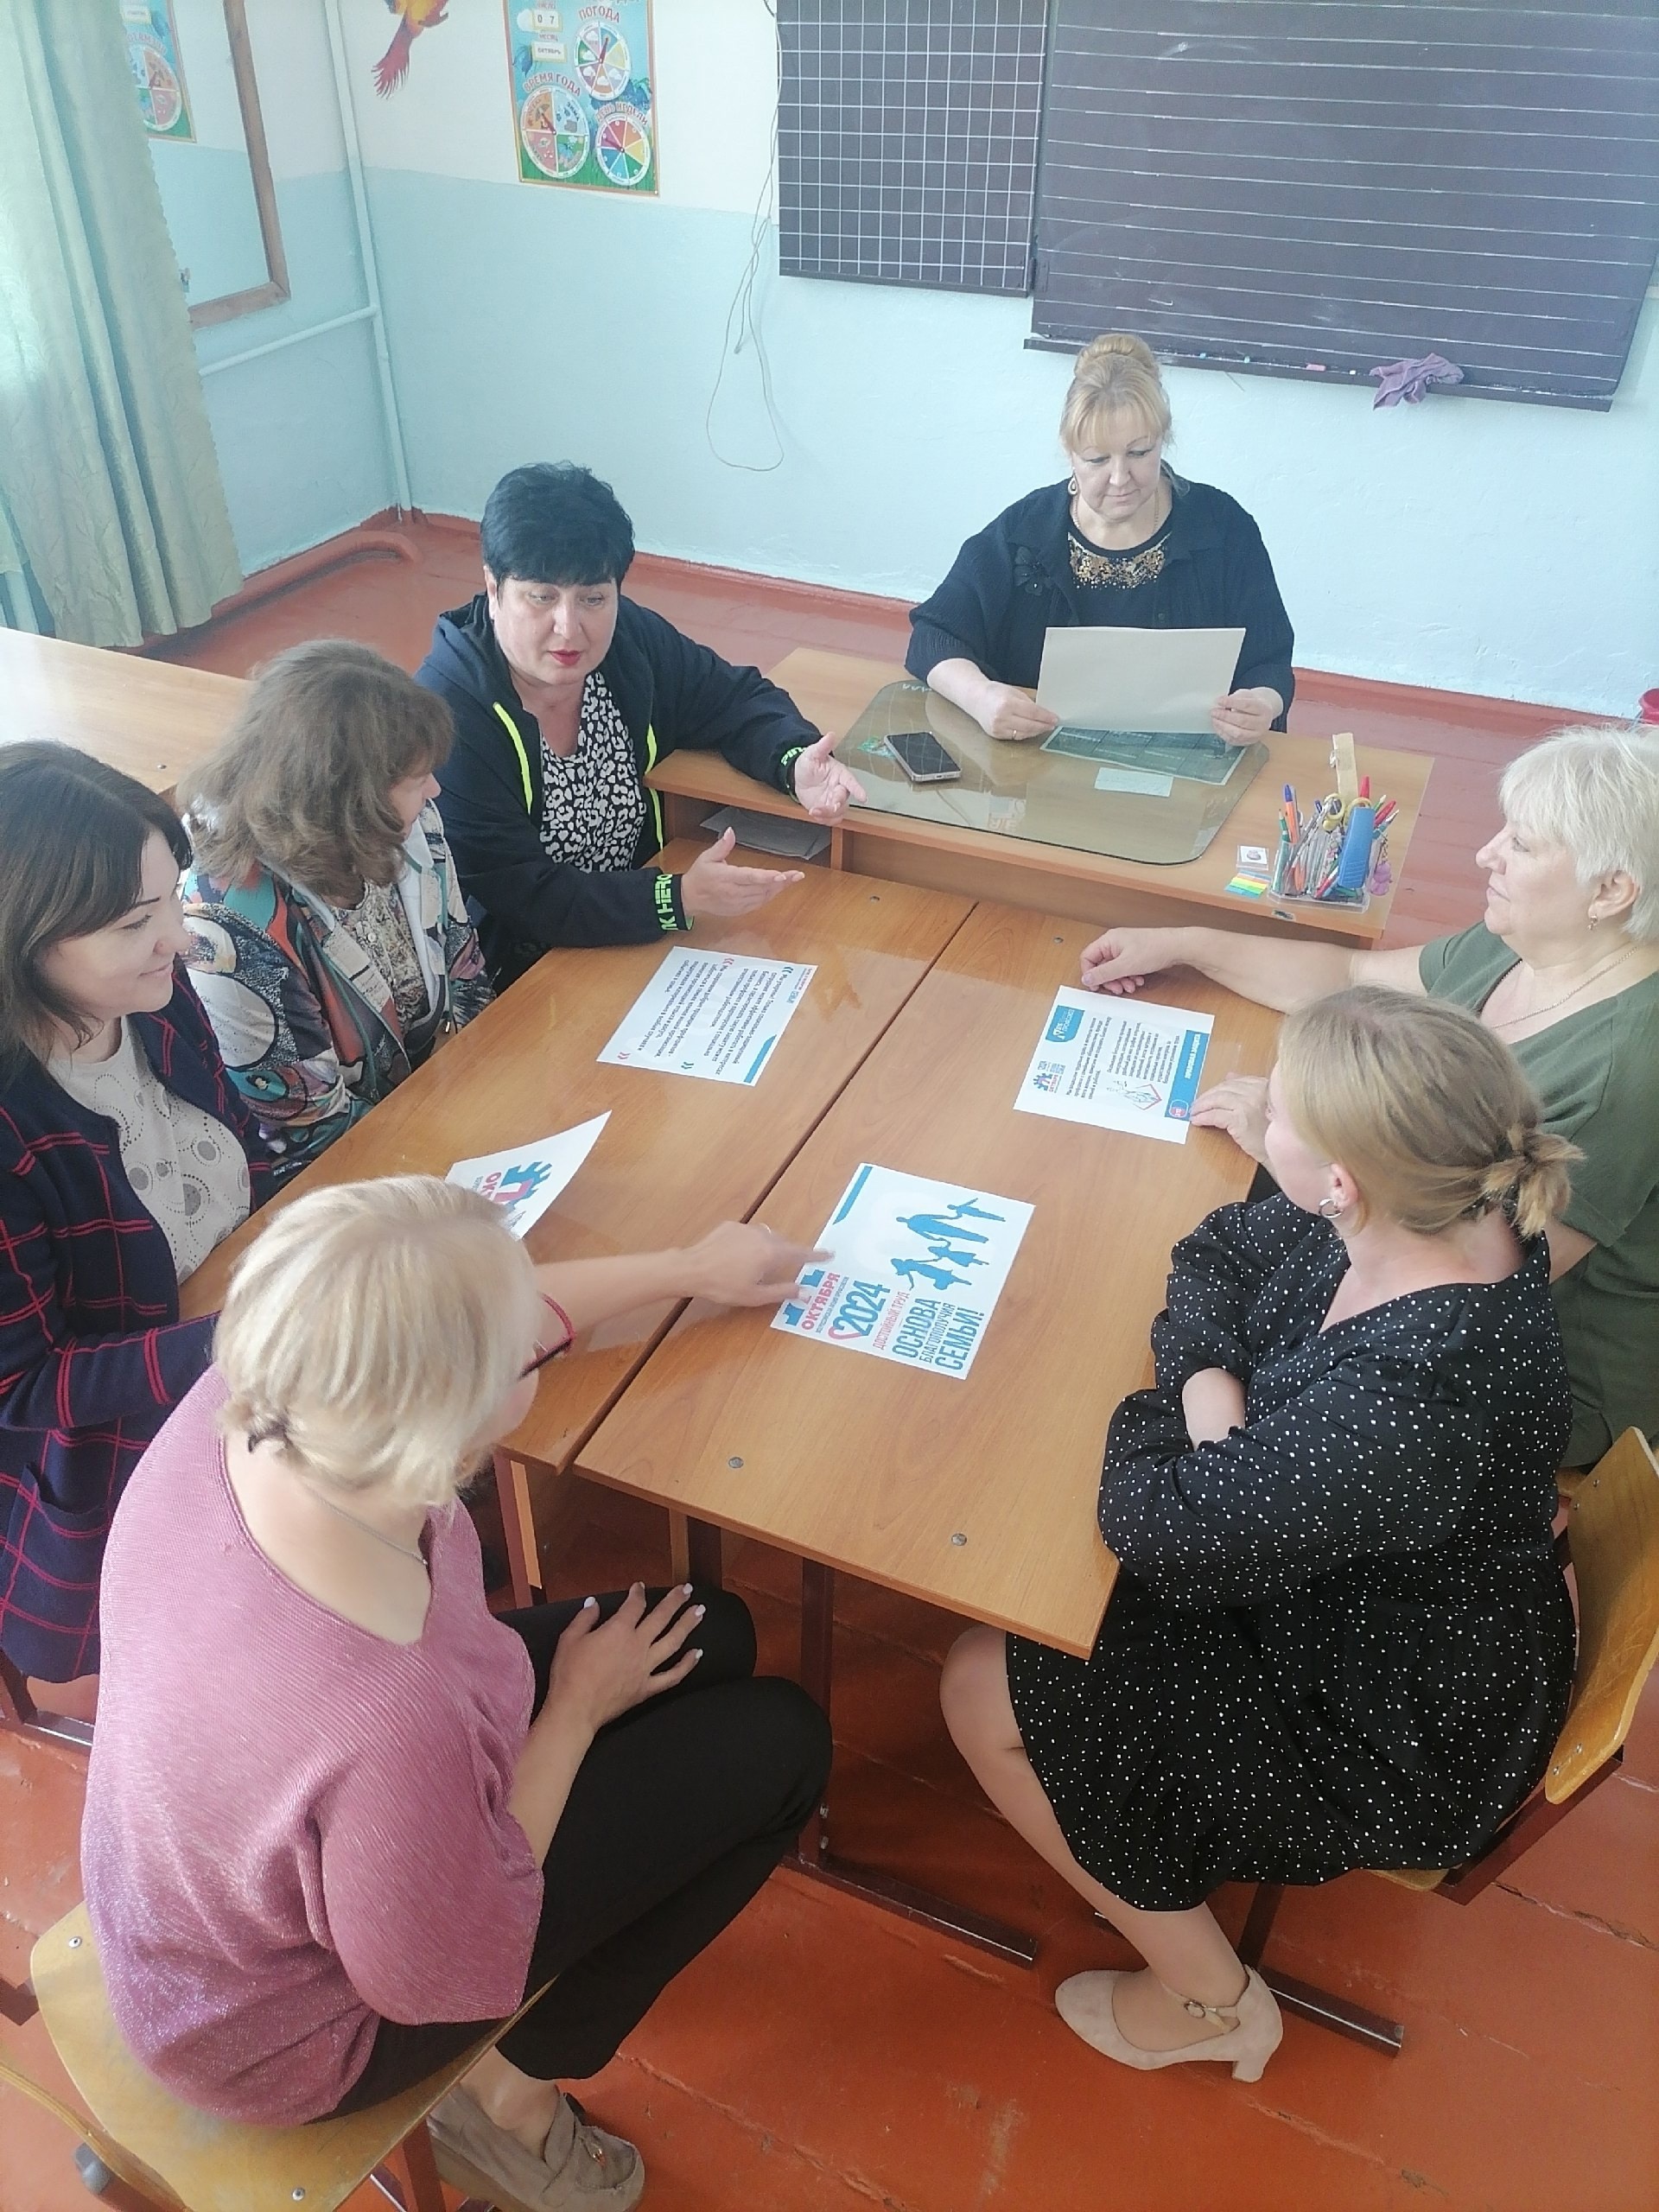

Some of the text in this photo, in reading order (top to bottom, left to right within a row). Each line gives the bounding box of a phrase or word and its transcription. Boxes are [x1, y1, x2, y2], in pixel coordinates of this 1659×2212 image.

[578, 5, 620, 23] ПОГОДА
[524, 72, 581, 97] ВРЕМЯ ГОДА
[801, 1272, 841, 1330] ОКТЯБРЯ
[833, 1281, 891, 1337] 2024
[872, 1291, 910, 1350] ДОСТОЙНЫЙ ТРУД
[892, 1298, 941, 1358] ОСНОВА
[919, 1302, 956, 1363] БЛАГОПОЛУЧИЯ
[935, 1306, 984, 1370] СЕМЬИ!
